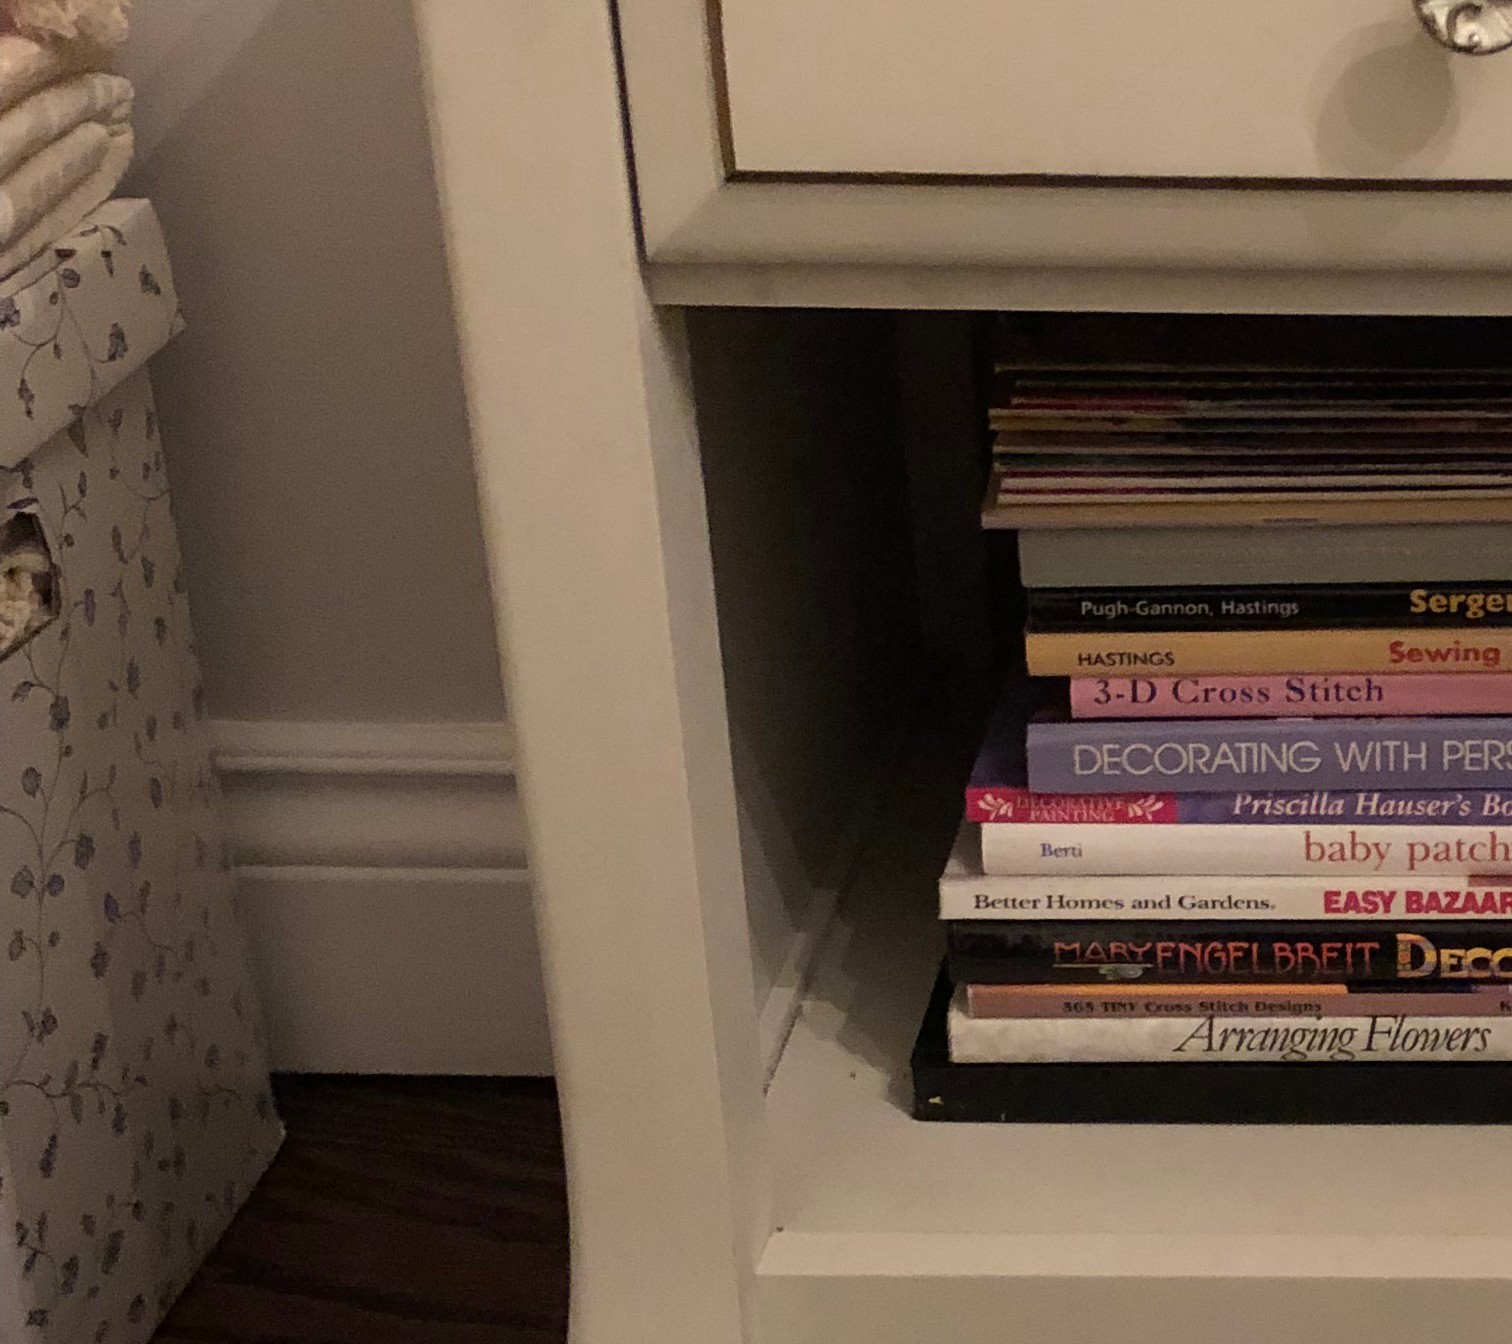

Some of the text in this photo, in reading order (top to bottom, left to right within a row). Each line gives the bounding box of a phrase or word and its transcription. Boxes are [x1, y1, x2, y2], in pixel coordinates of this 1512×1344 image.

[1081, 600, 1299, 618] Pugh-Gannon, Hastings
[1078, 651, 1175, 667] HASTINGS
[1389, 641, 1500, 667] Sewing
[1094, 676, 1384, 706] 3-D Cross Stitch
[1074, 742, 1321, 776] DECORATING
[1335, 739, 1428, 774] WITH
[1016, 794, 1127, 811] DECORATIVE
[1233, 792, 1344, 817] Priscilla
[1354, 793, 1472, 818] Hauser's
[1029, 809, 1115, 824] PAINTING
[1040, 842, 1083, 859] Berti
[1304, 831, 1393, 870] baby
[973, 893, 1040, 910] Better
[1047, 893, 1125, 910] Homes
[1131, 893, 1172, 910] and
[1324, 890, 1396, 915] EASY
[1053, 940, 1380, 980] MARY ENGELBREIT
[1102, 1001, 1139, 1014] TINY
[1145, 1001, 1192, 1014] Cross
[1199, 1000, 1248, 1014] Stitch
[1255, 1000, 1322, 1016] Designs
[1174, 1015, 1492, 1061] Arranging Flowers
